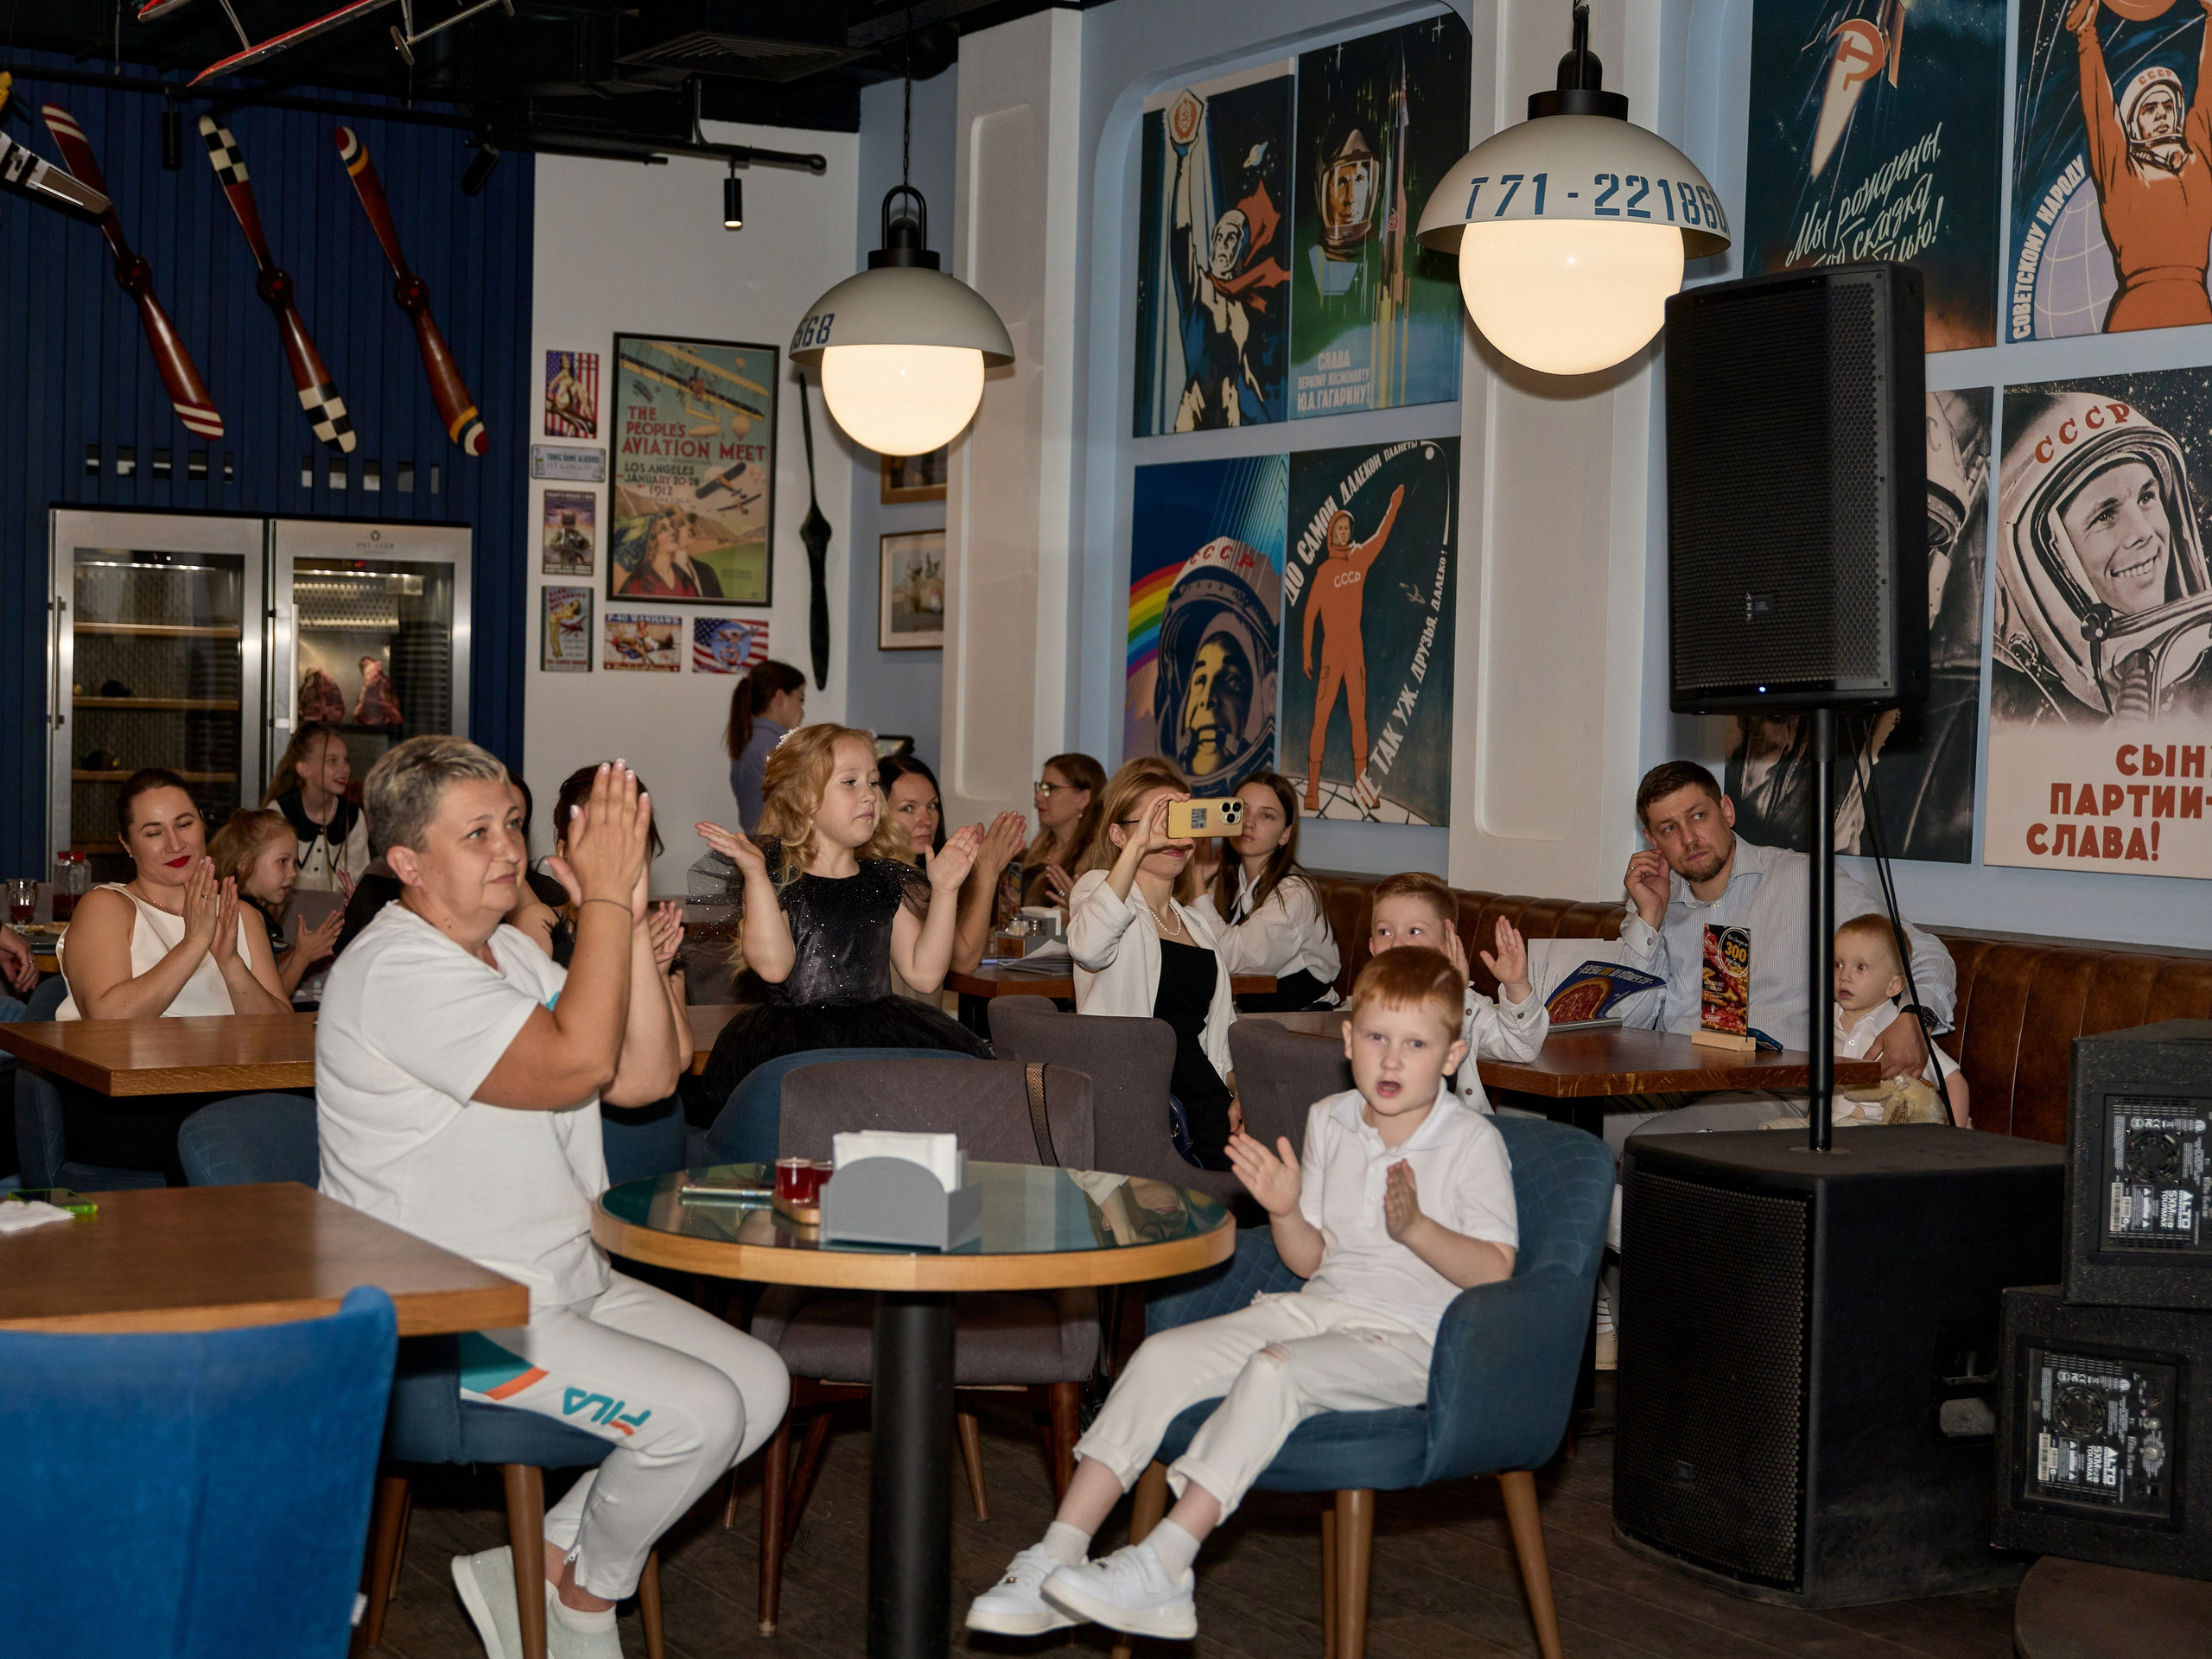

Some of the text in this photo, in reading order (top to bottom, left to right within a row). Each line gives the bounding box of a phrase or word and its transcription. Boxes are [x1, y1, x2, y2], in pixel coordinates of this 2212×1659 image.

[2139, 67, 2172, 86] СССР
[1785, 200, 1832, 267] Мы
[1833, 121, 1942, 250] рождены,
[1853, 173, 1934, 260] сказку
[2012, 153, 2087, 340] СОВЕТСКОМУ НАРОДУ
[1318, 350, 1351, 371] СЛАВА
[1298, 367, 1370, 390] ПЕРВОМУ КОСМОНАВТУ
[1317, 382, 1370, 410] ГАГАРИНУ!
[628, 405, 657, 421] THE
[626, 421, 686, 437] PEOPLE'S
[2034, 403, 2131, 464] СССР
[621, 437, 766, 461] AVIATION MEET
[624, 462, 695, 475] LOS ANGELES
[625, 474, 671, 485] JANUARY
[650, 485, 673, 496] 1912
[1284, 561, 1305, 607] ДО
[1383, 441, 1419, 461] ПЛАНЕТЫ
[1190, 545, 1255, 568] СССР
[1334, 570, 1361, 588] СССР
[1351, 767, 1382, 816] НЕ
[1369, 722, 1404, 776] ТАК
[2115, 744, 2212, 779] СЫН
[2025, 821, 2160, 861] СЛАВА!
[1725, 941, 1747, 963] 300
[2182, 1189, 2194, 1229] ALTO
[563, 1387, 652, 1436] FILA
[2107, 1446, 2119, 1486] ALTO
